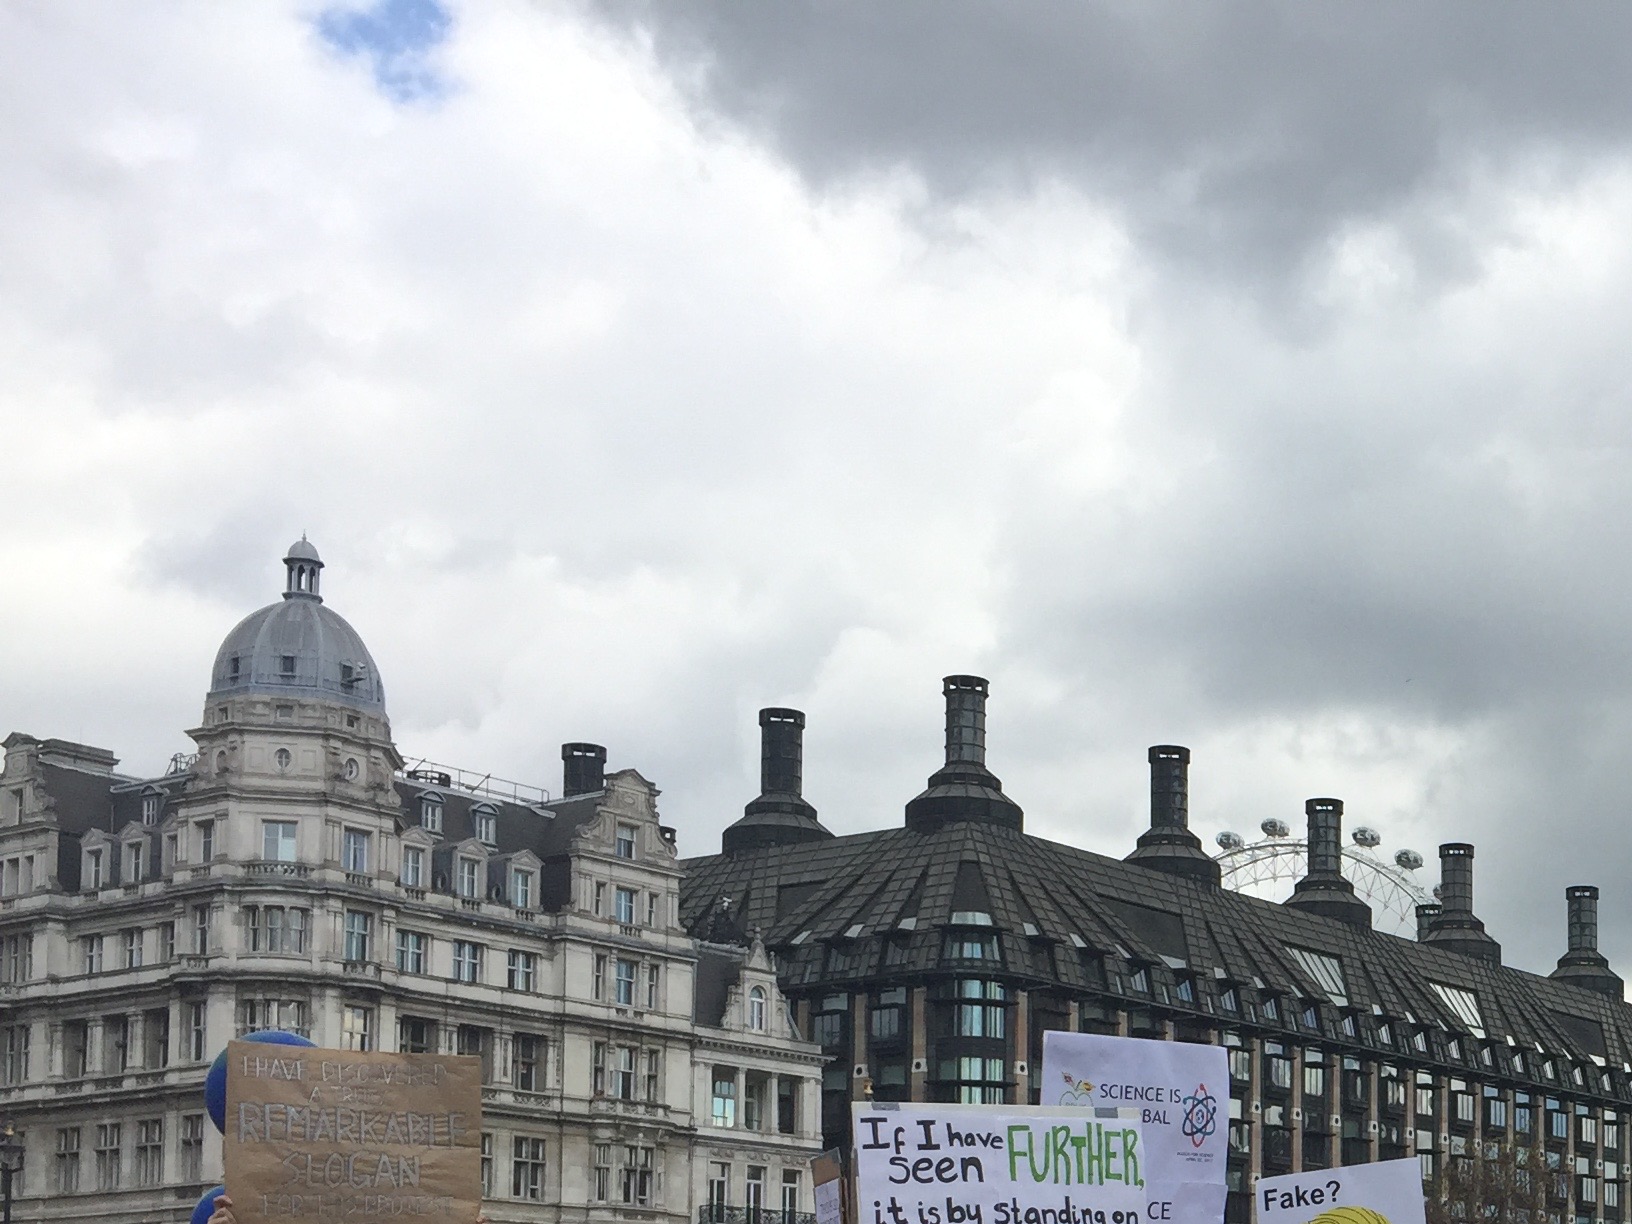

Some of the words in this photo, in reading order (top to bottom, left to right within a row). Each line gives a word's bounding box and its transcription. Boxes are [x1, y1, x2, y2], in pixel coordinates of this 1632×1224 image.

[256, 1056, 308, 1081] HAVE
[321, 1061, 448, 1086] DISCOVERED
[1100, 1083, 1164, 1104] SCIENCE
[1169, 1088, 1181, 1104] IS
[238, 1102, 467, 1148] REMARKABLE
[1142, 1109, 1171, 1125] BAL
[860, 1117, 905, 1155] If
[916, 1119, 941, 1151] I
[946, 1122, 1004, 1151] have
[283, 1151, 421, 1189] SLOGAN
[1007, 1121, 1145, 1190] FURTHER,
[1263, 1180, 1342, 1211] Fake?
